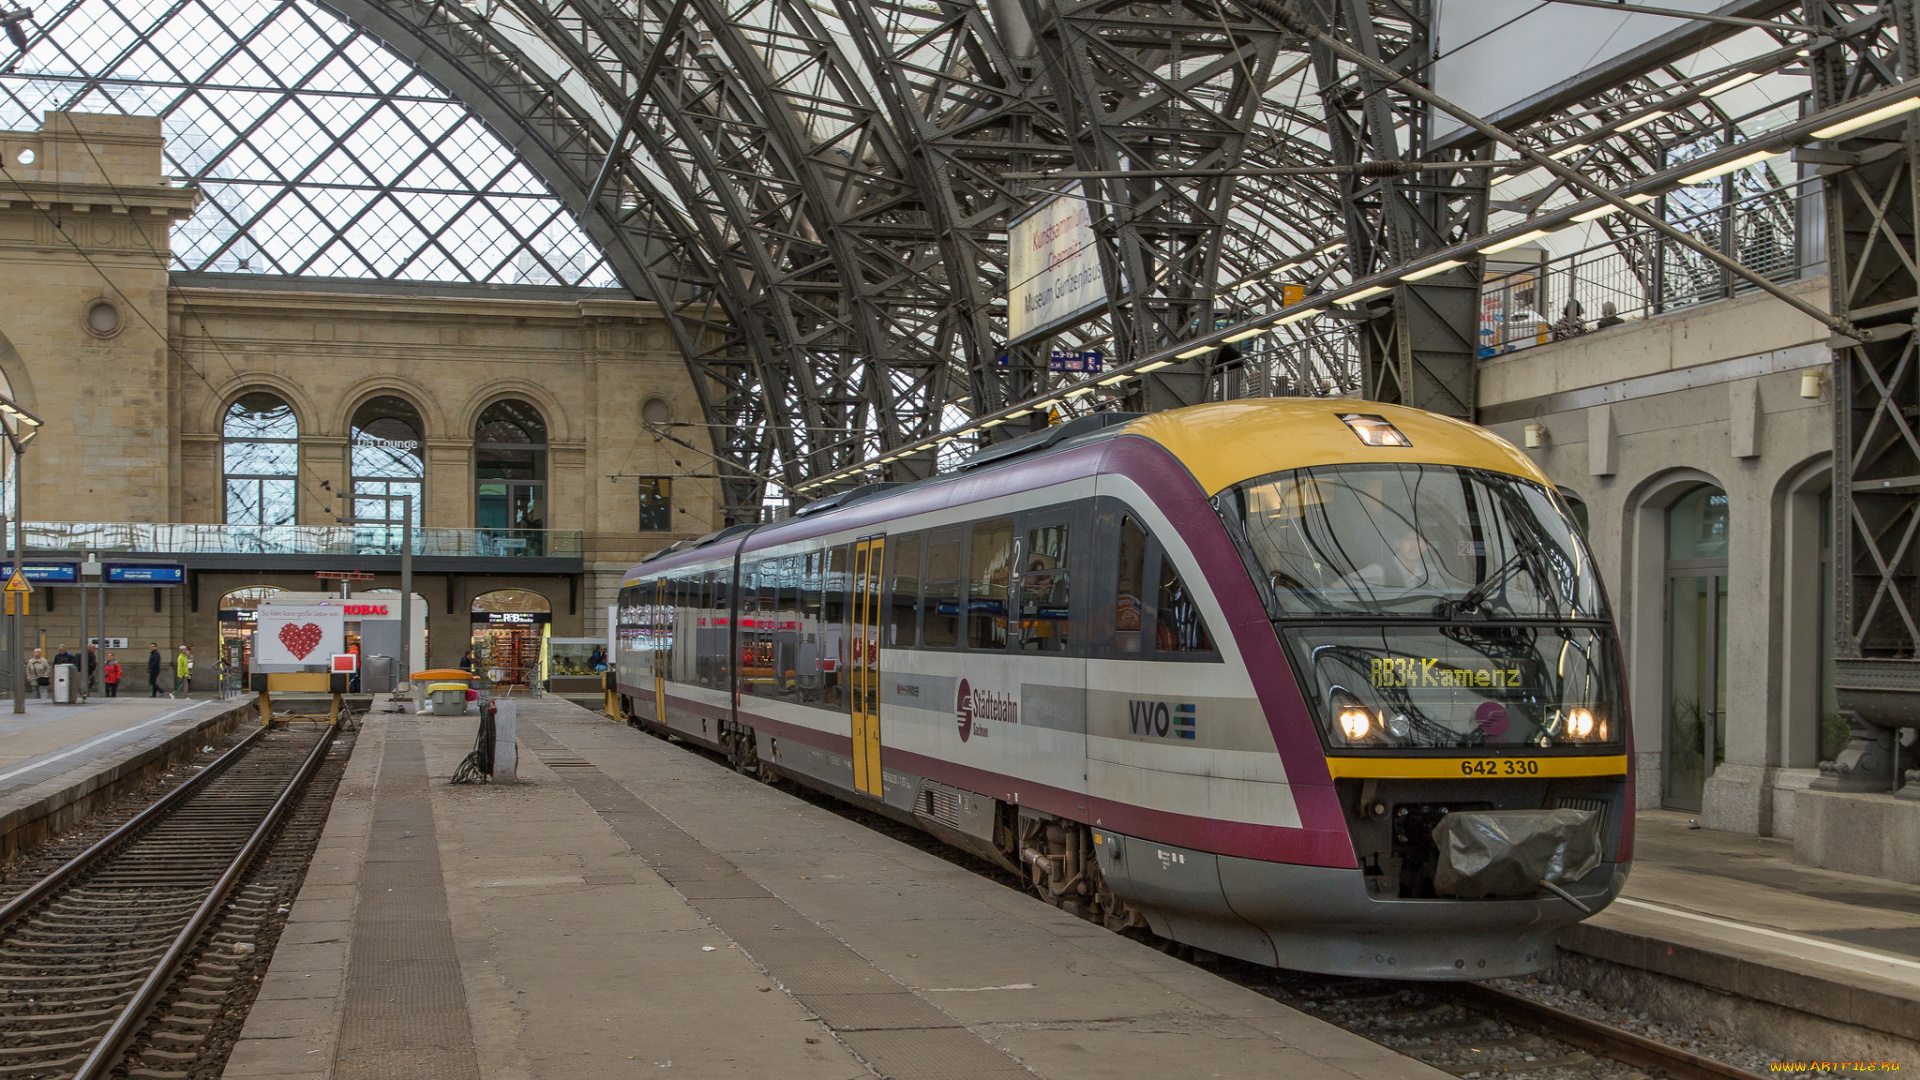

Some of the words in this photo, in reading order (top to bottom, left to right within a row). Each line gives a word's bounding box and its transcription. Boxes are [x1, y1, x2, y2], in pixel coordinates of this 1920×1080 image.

[1047, 239, 1083, 273] Chemnitz
[1024, 287, 1054, 315] Museum
[357, 439, 374, 448] DB
[377, 440, 418, 451] Lounge
[1012, 540, 1021, 578] 2
[2, 567, 12, 575] 10
[174, 569, 181, 577] 9
[335, 604, 388, 616] ROBAG
[1371, 658, 1418, 687] RB34
[1421, 658, 1521, 687] Kamenz
[973, 688, 1018, 724] Städtebahn
[1129, 700, 1169, 737] VVO
[973, 722, 989, 738] Sachsen
[1461, 760, 1498, 775] 642
[1503, 760, 1538, 775] 330
